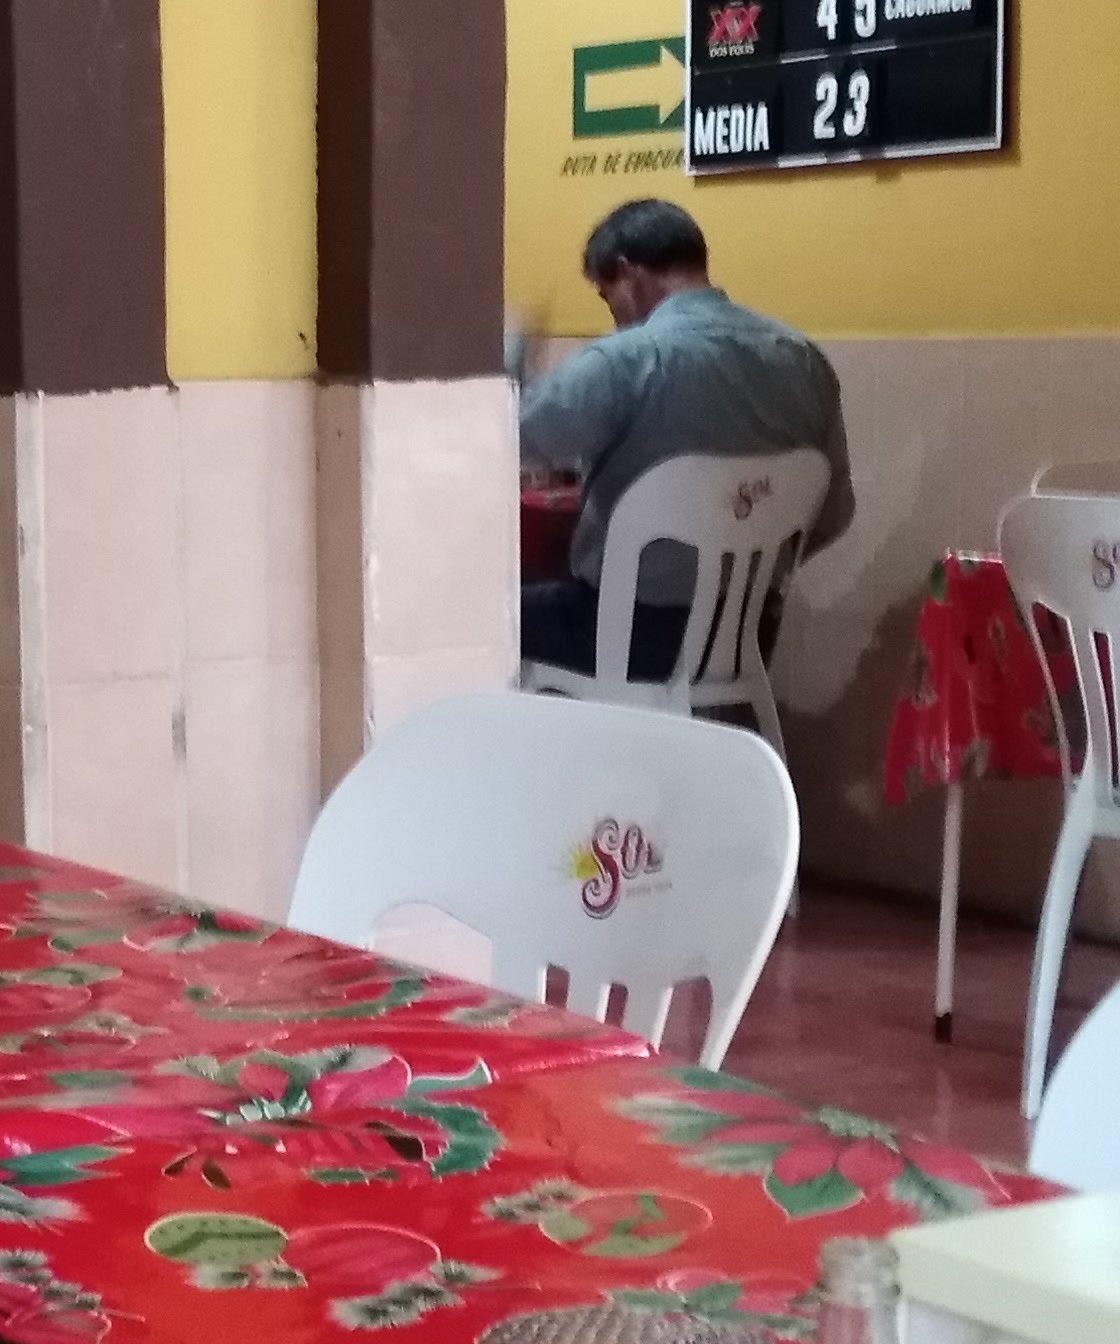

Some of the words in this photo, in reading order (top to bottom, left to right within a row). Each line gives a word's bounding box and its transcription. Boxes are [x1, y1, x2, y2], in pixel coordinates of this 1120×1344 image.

[693, 100, 770, 156] MEDIA
[812, 68, 871, 140] 23
[582, 818, 663, 920] SOL
